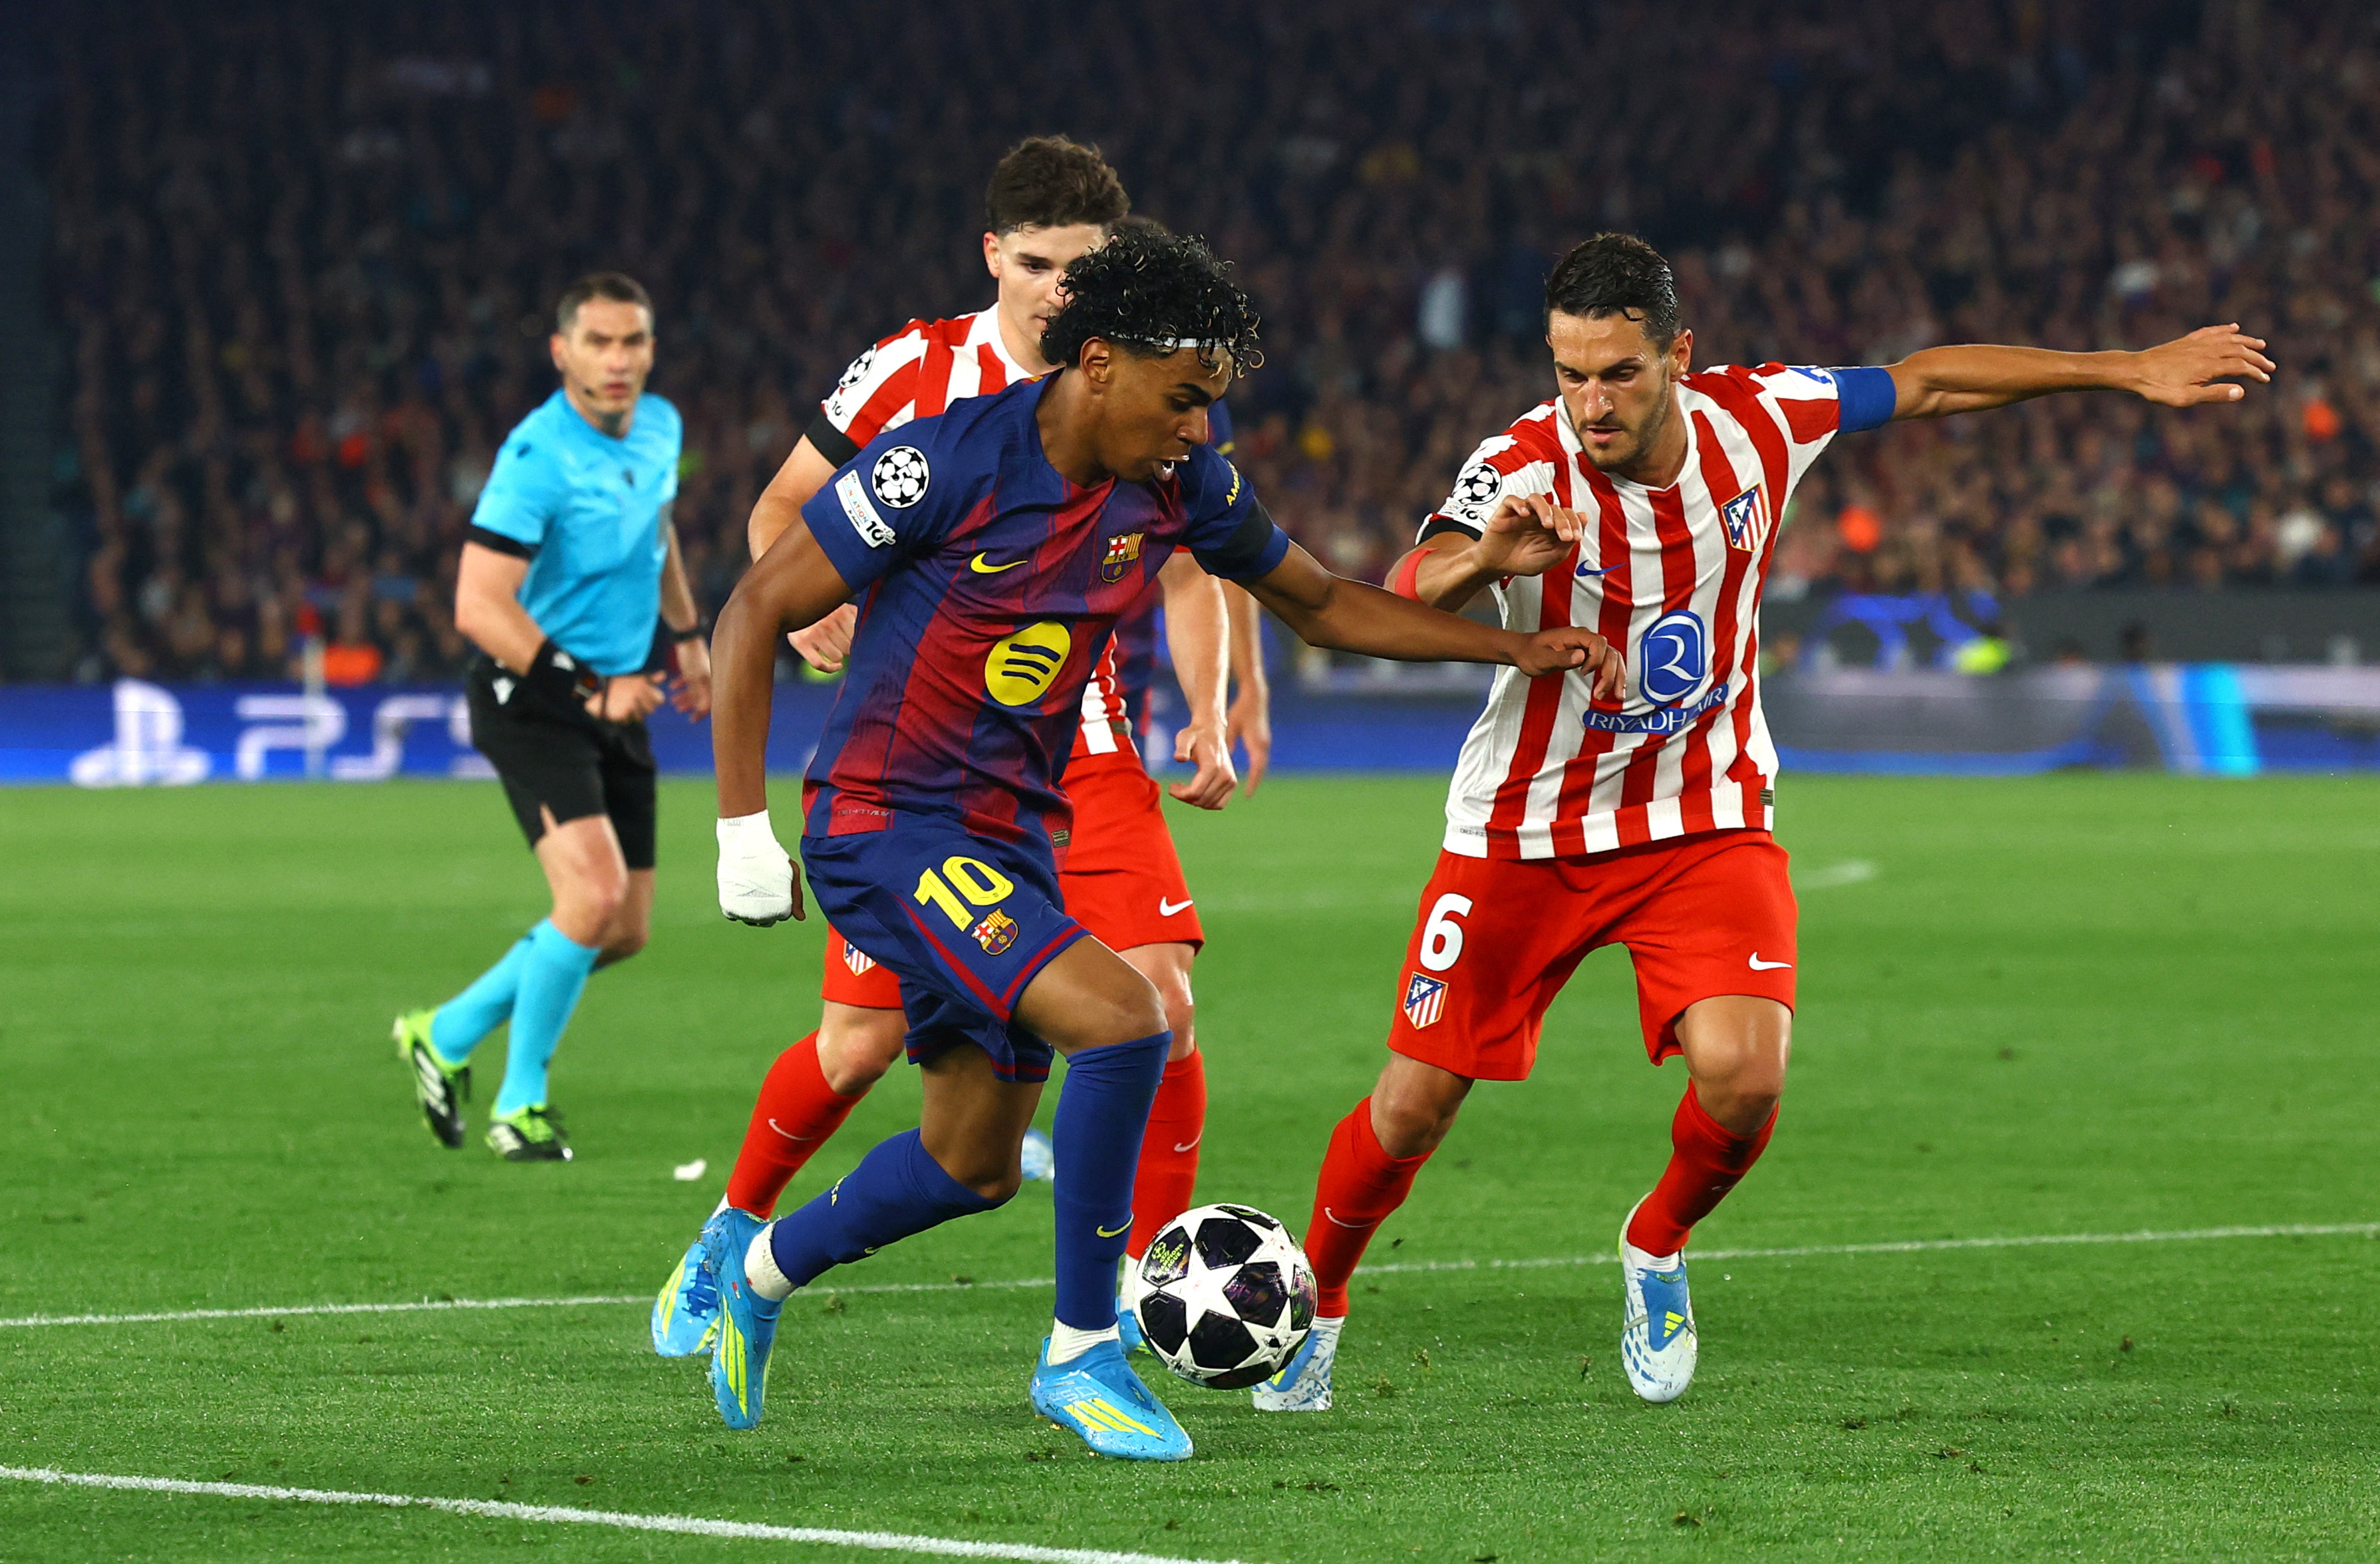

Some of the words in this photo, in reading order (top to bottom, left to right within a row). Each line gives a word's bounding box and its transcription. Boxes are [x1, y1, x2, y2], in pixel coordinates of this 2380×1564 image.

[1589, 710, 1688, 732] RIYADH
[1692, 687, 1723, 716] AIR
[913, 856, 1014, 932] 10
[1419, 892, 1473, 972] 6
